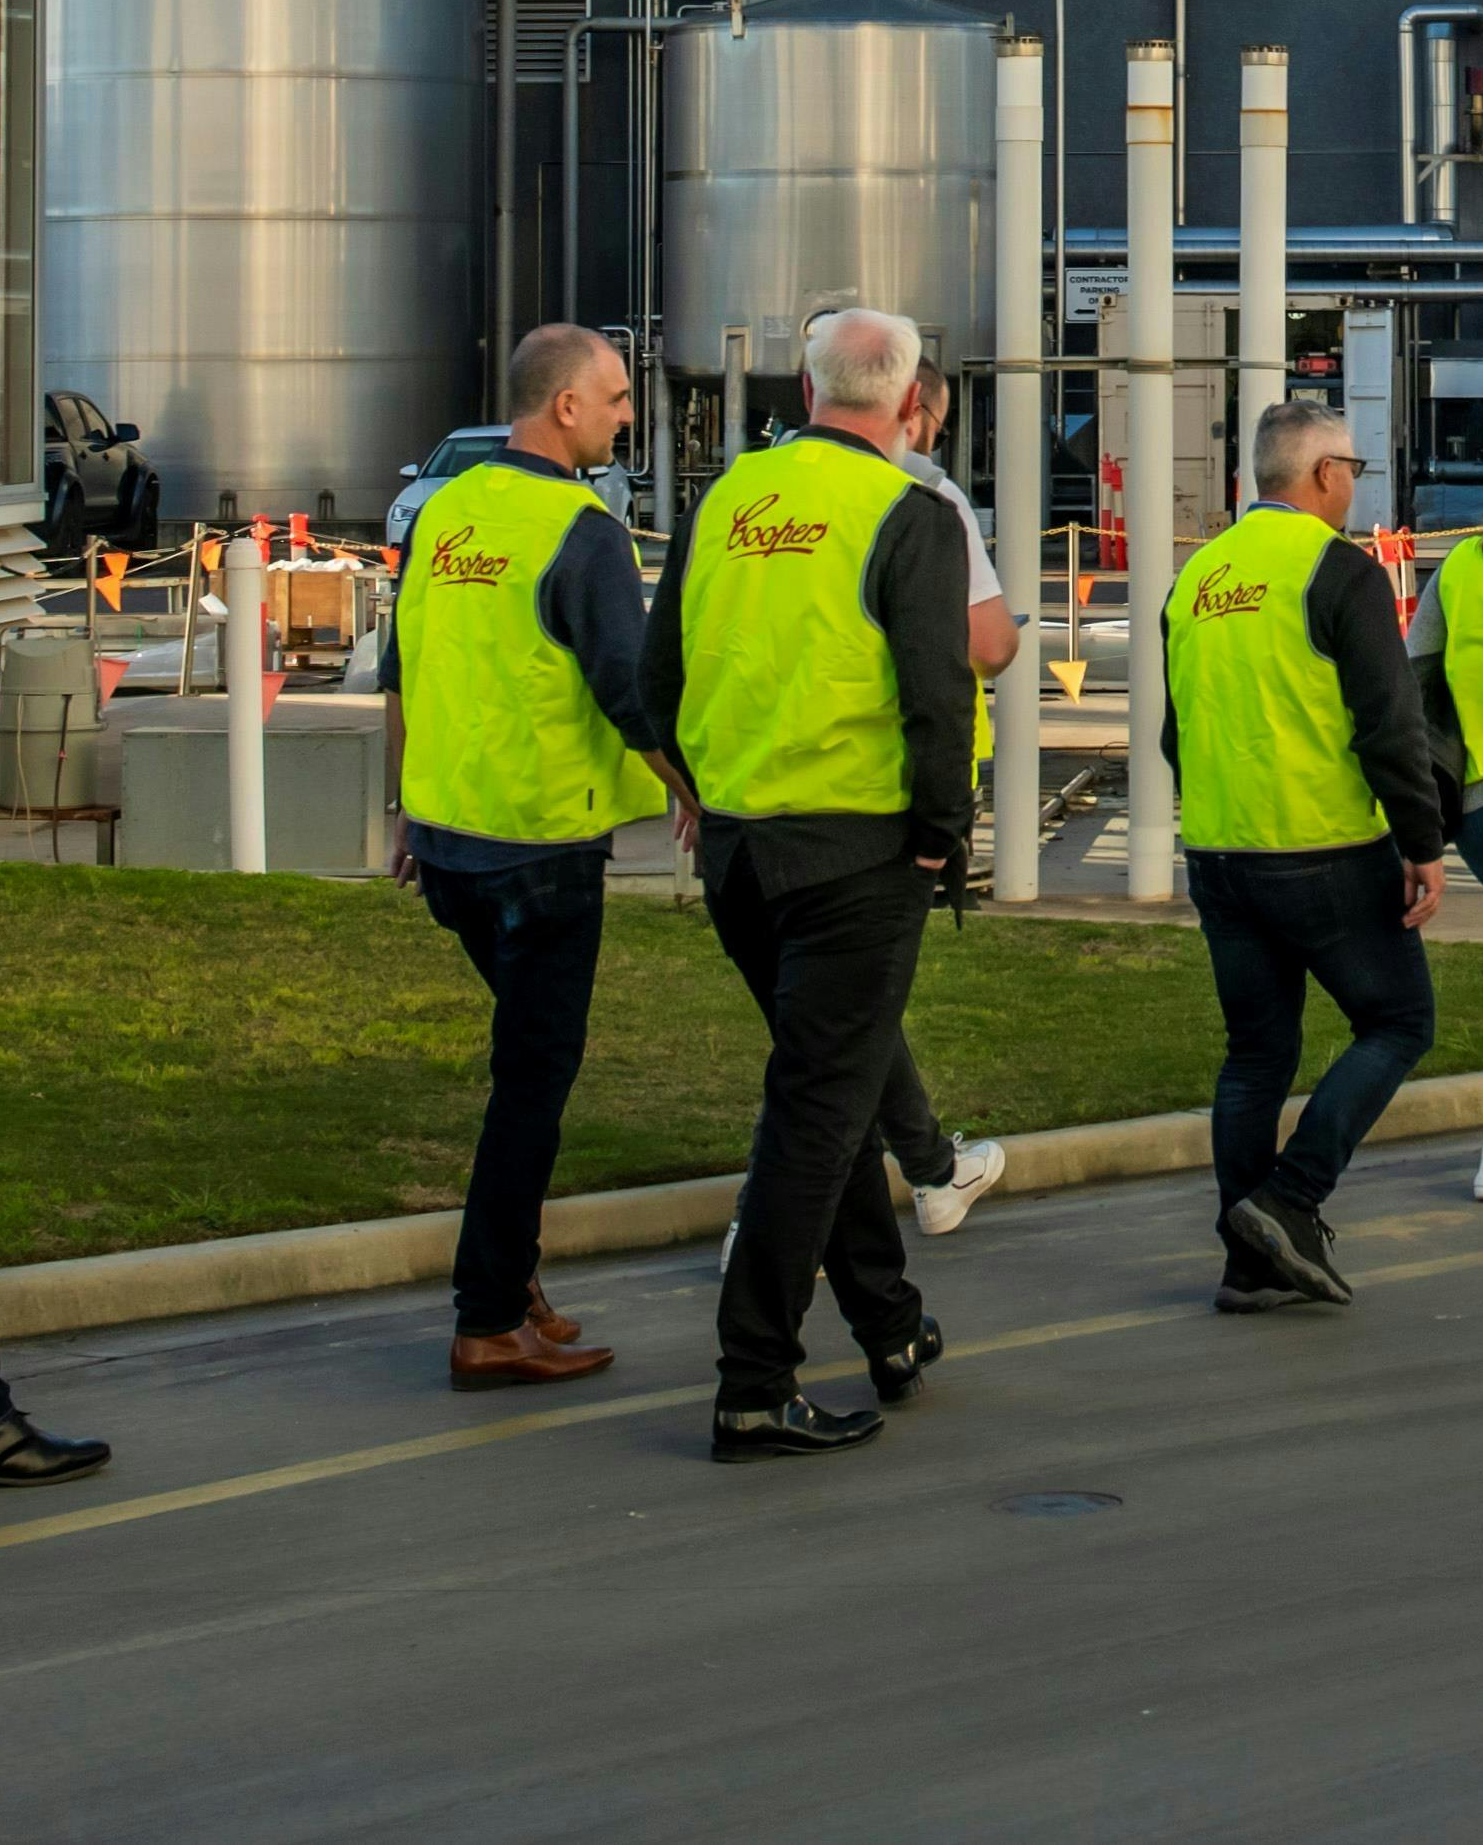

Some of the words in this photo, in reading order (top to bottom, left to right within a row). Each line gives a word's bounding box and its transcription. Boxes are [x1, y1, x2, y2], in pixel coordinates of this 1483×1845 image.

[1080, 286, 1120, 294] PARKING
[431, 525, 510, 586] Coopers
[727, 493, 830, 559] Coopers
[1192, 563, 1270, 620] Coopers
